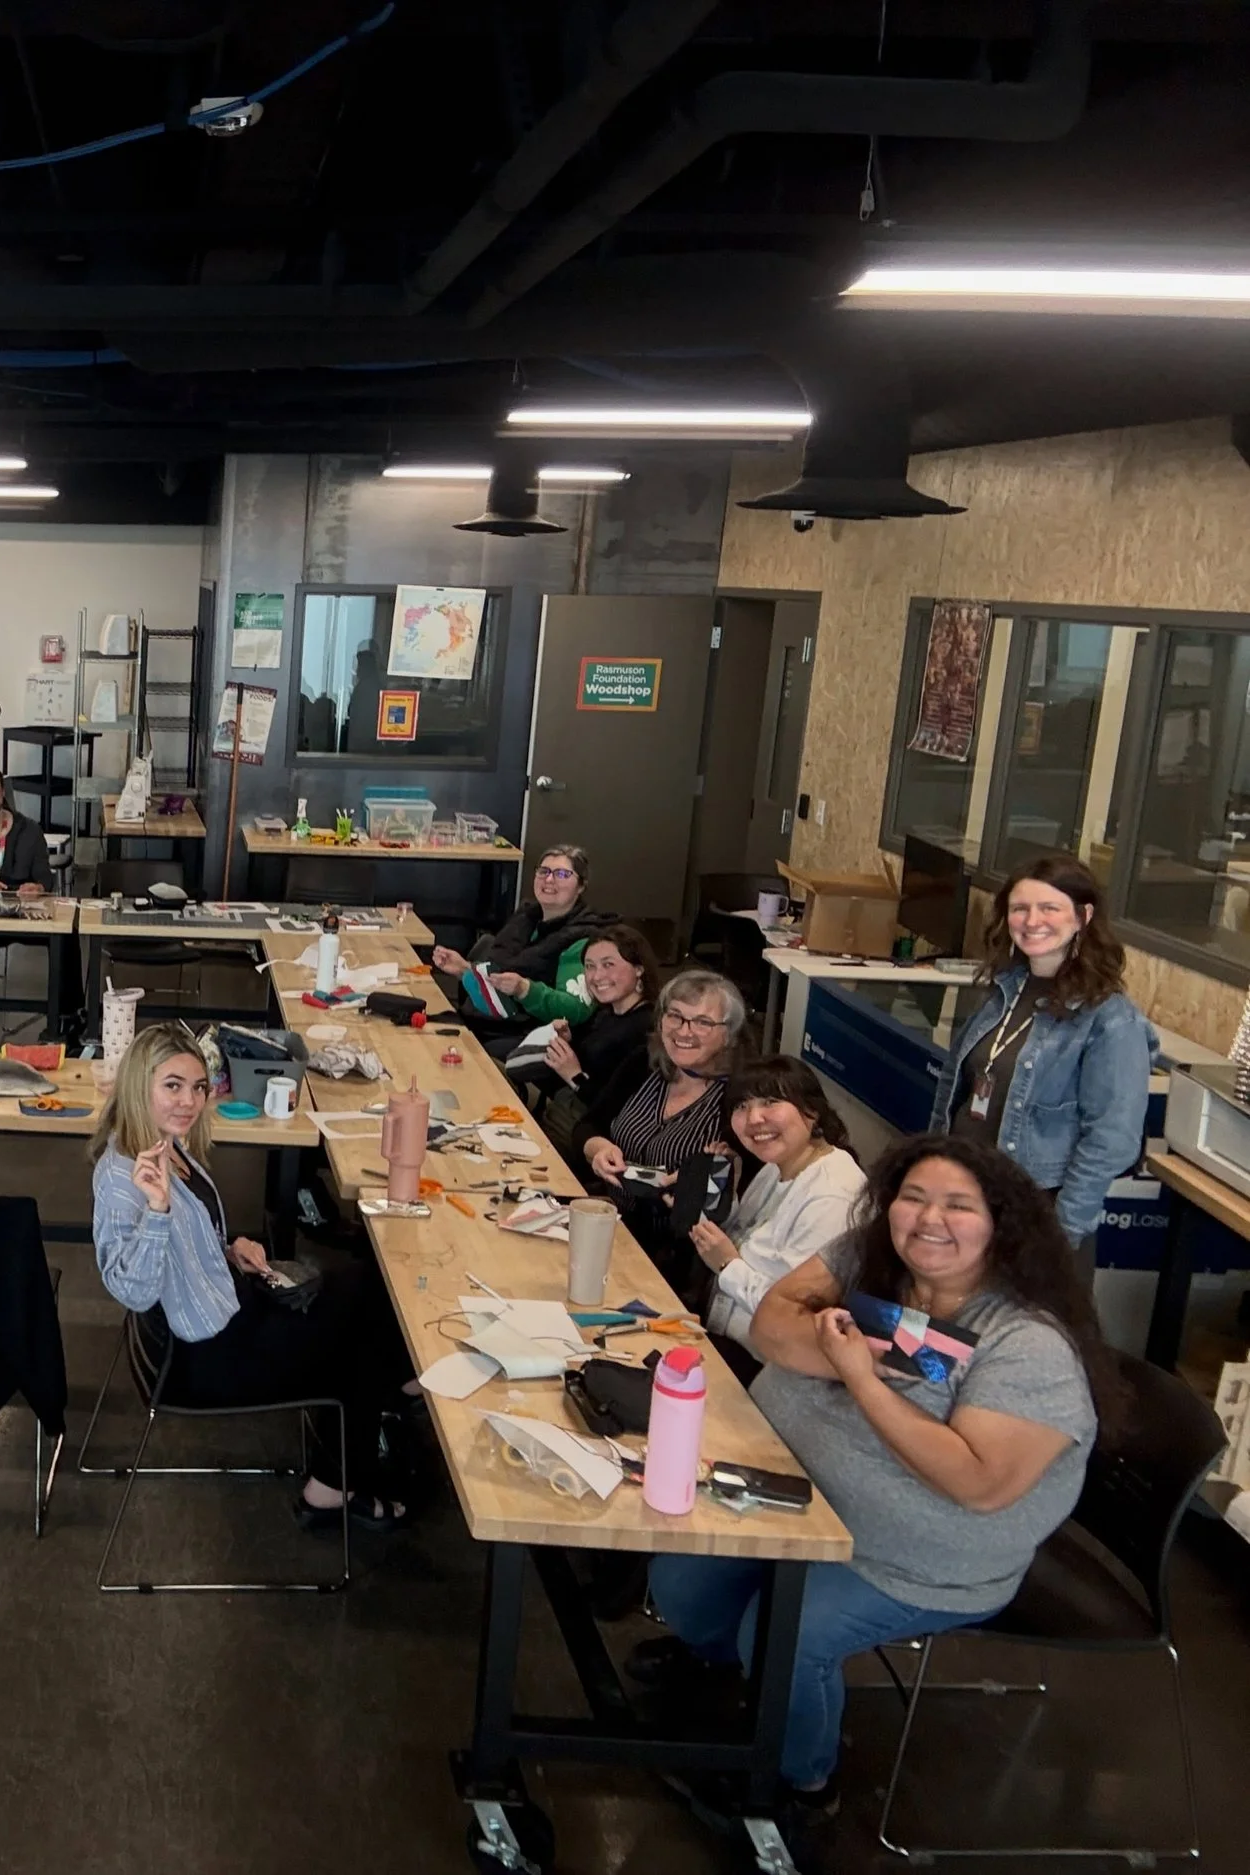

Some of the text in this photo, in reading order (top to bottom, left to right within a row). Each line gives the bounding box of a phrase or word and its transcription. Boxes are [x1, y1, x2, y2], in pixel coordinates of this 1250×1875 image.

[596, 664, 645, 675] Rasmuson
[592, 673, 646, 684] Foundation
[586, 683, 652, 698] Woodshop
